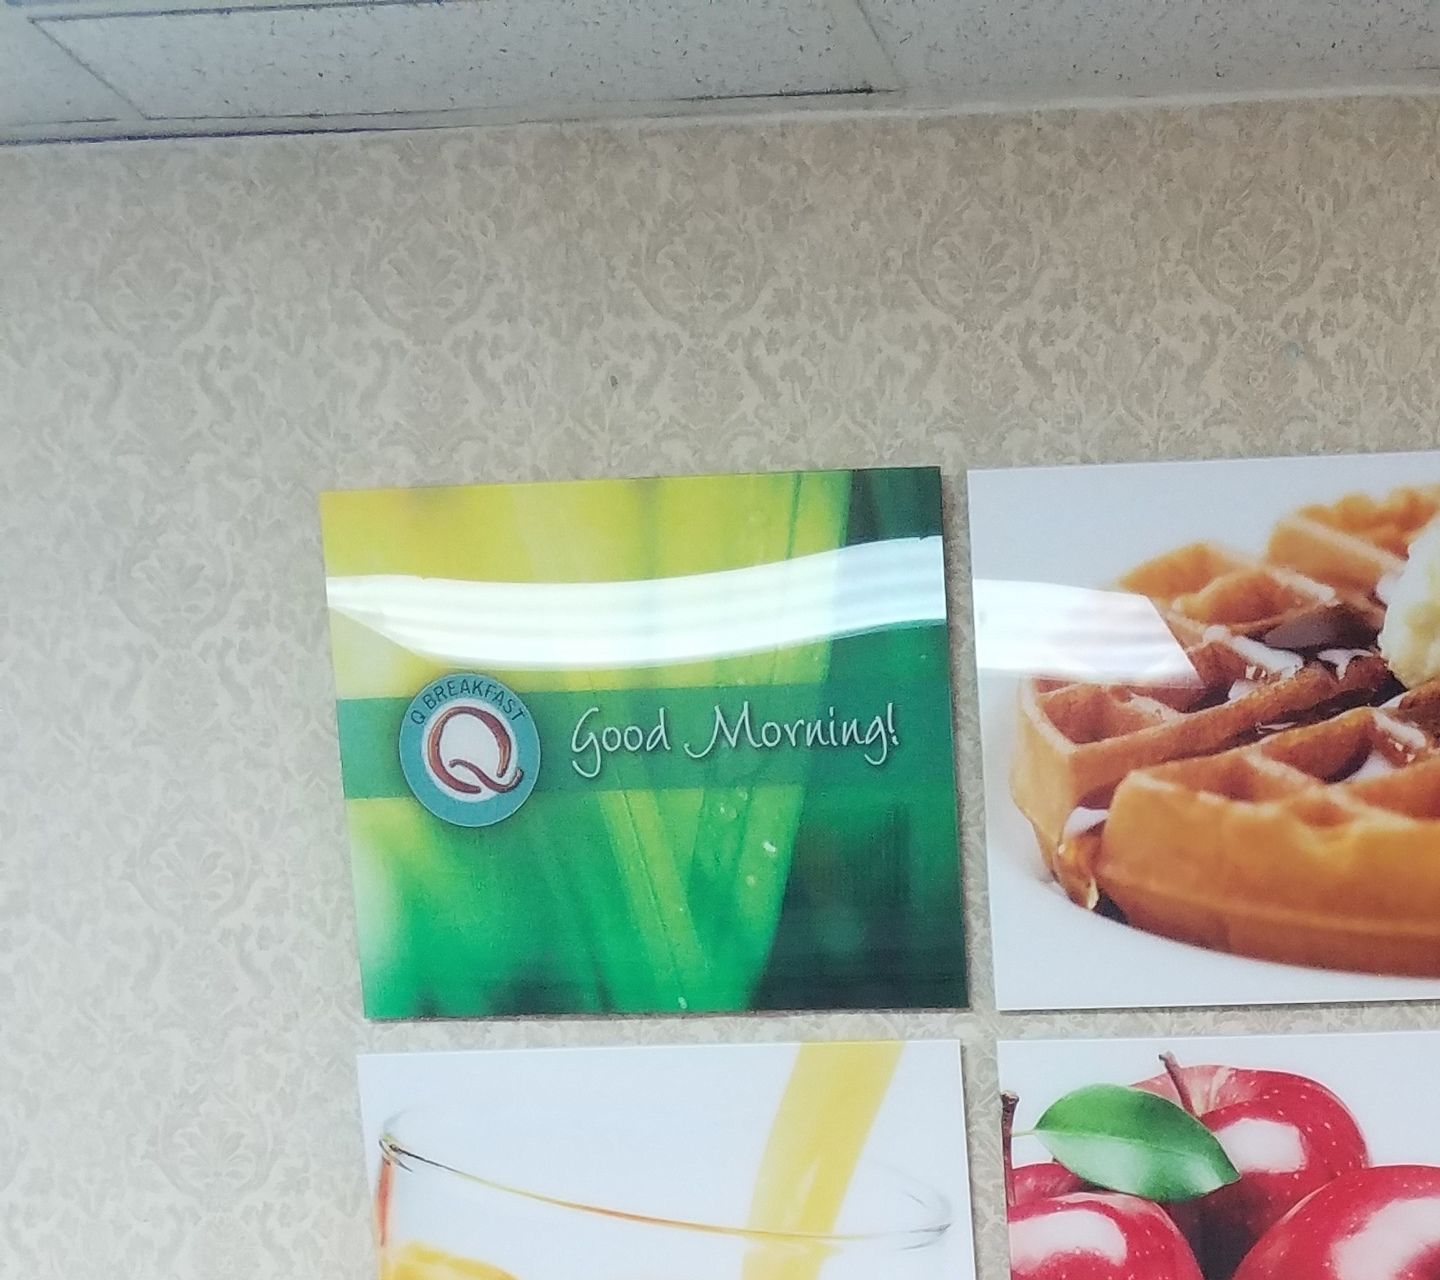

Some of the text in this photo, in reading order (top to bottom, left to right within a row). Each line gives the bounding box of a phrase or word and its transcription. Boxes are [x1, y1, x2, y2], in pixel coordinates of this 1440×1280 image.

[410, 679, 526, 725] Q BREAKFAST
[571, 701, 901, 778] Good Morning!
[428, 705, 524, 794] Q
